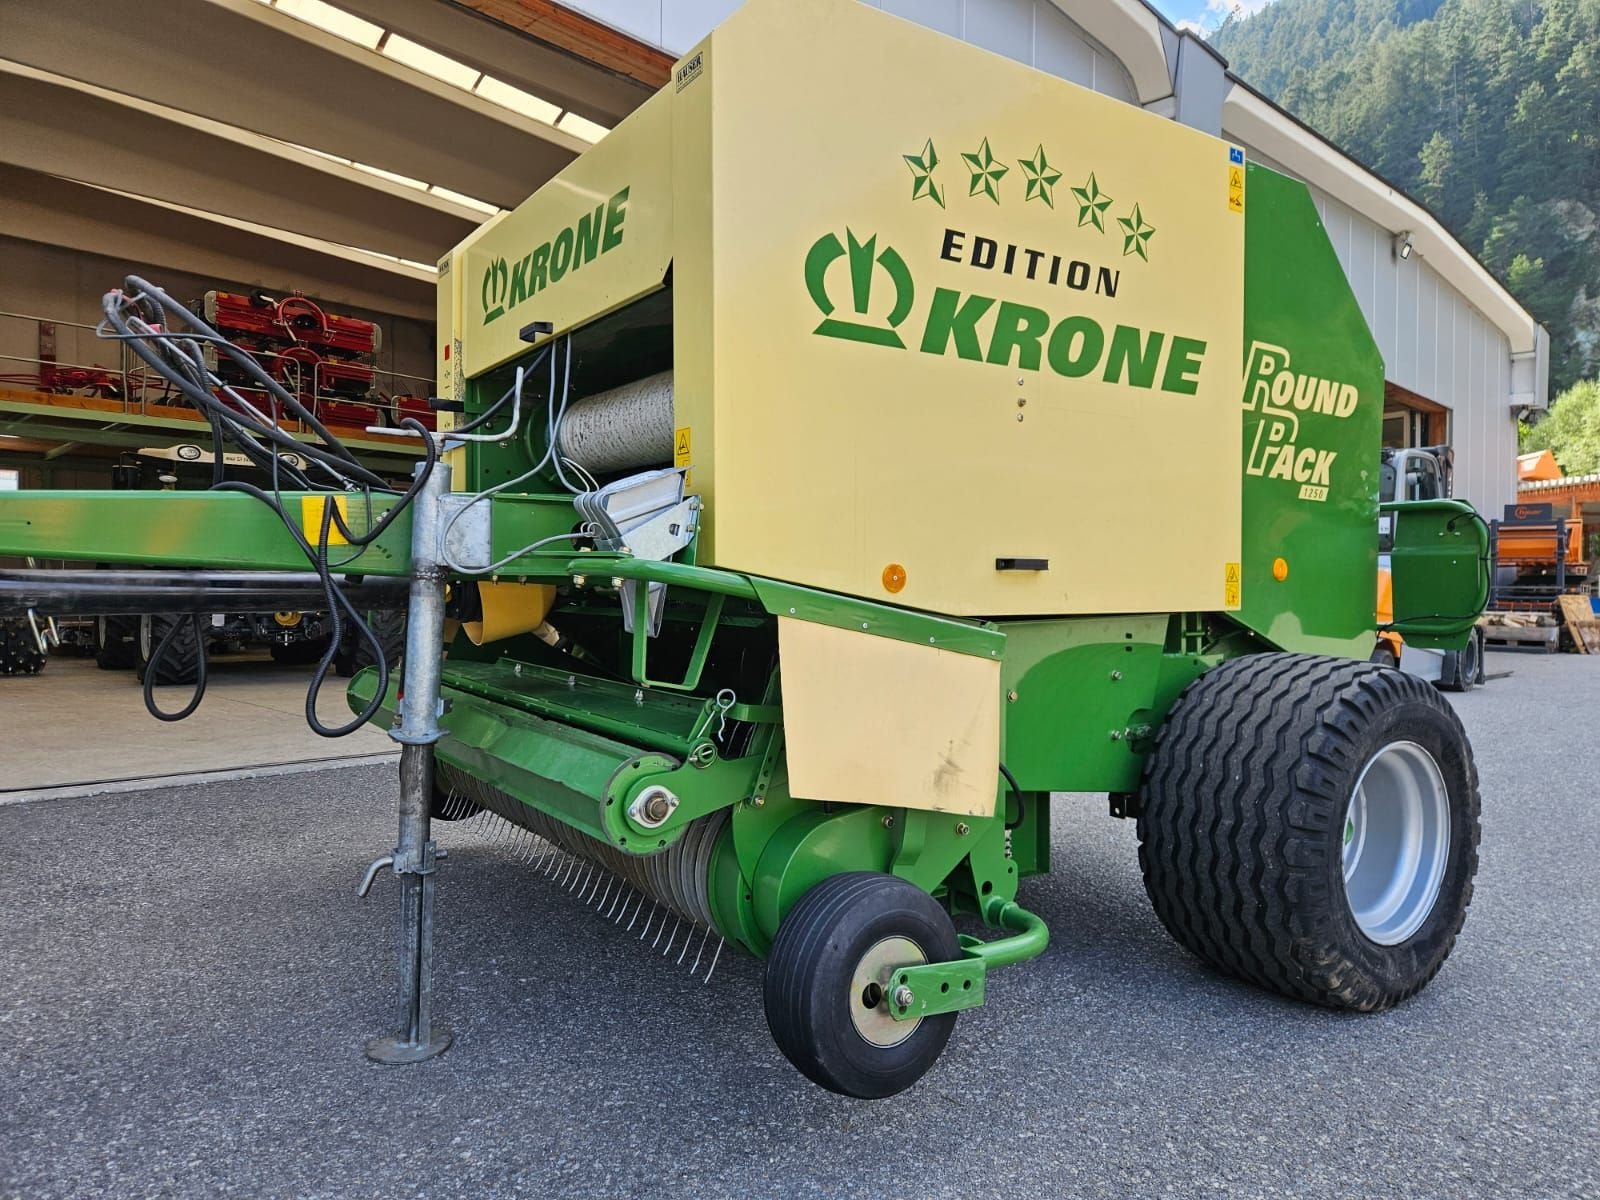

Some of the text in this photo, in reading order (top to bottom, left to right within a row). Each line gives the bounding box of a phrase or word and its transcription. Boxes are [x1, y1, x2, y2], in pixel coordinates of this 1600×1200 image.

[508, 185, 630, 310] KRONE
[940, 228, 1121, 298] EDITION
[919, 287, 1207, 396] KRONE
[1241, 340, 1358, 418] ROUND
[1246, 405, 1338, 486] PACK
[1303, 487, 1324, 499] 1250
